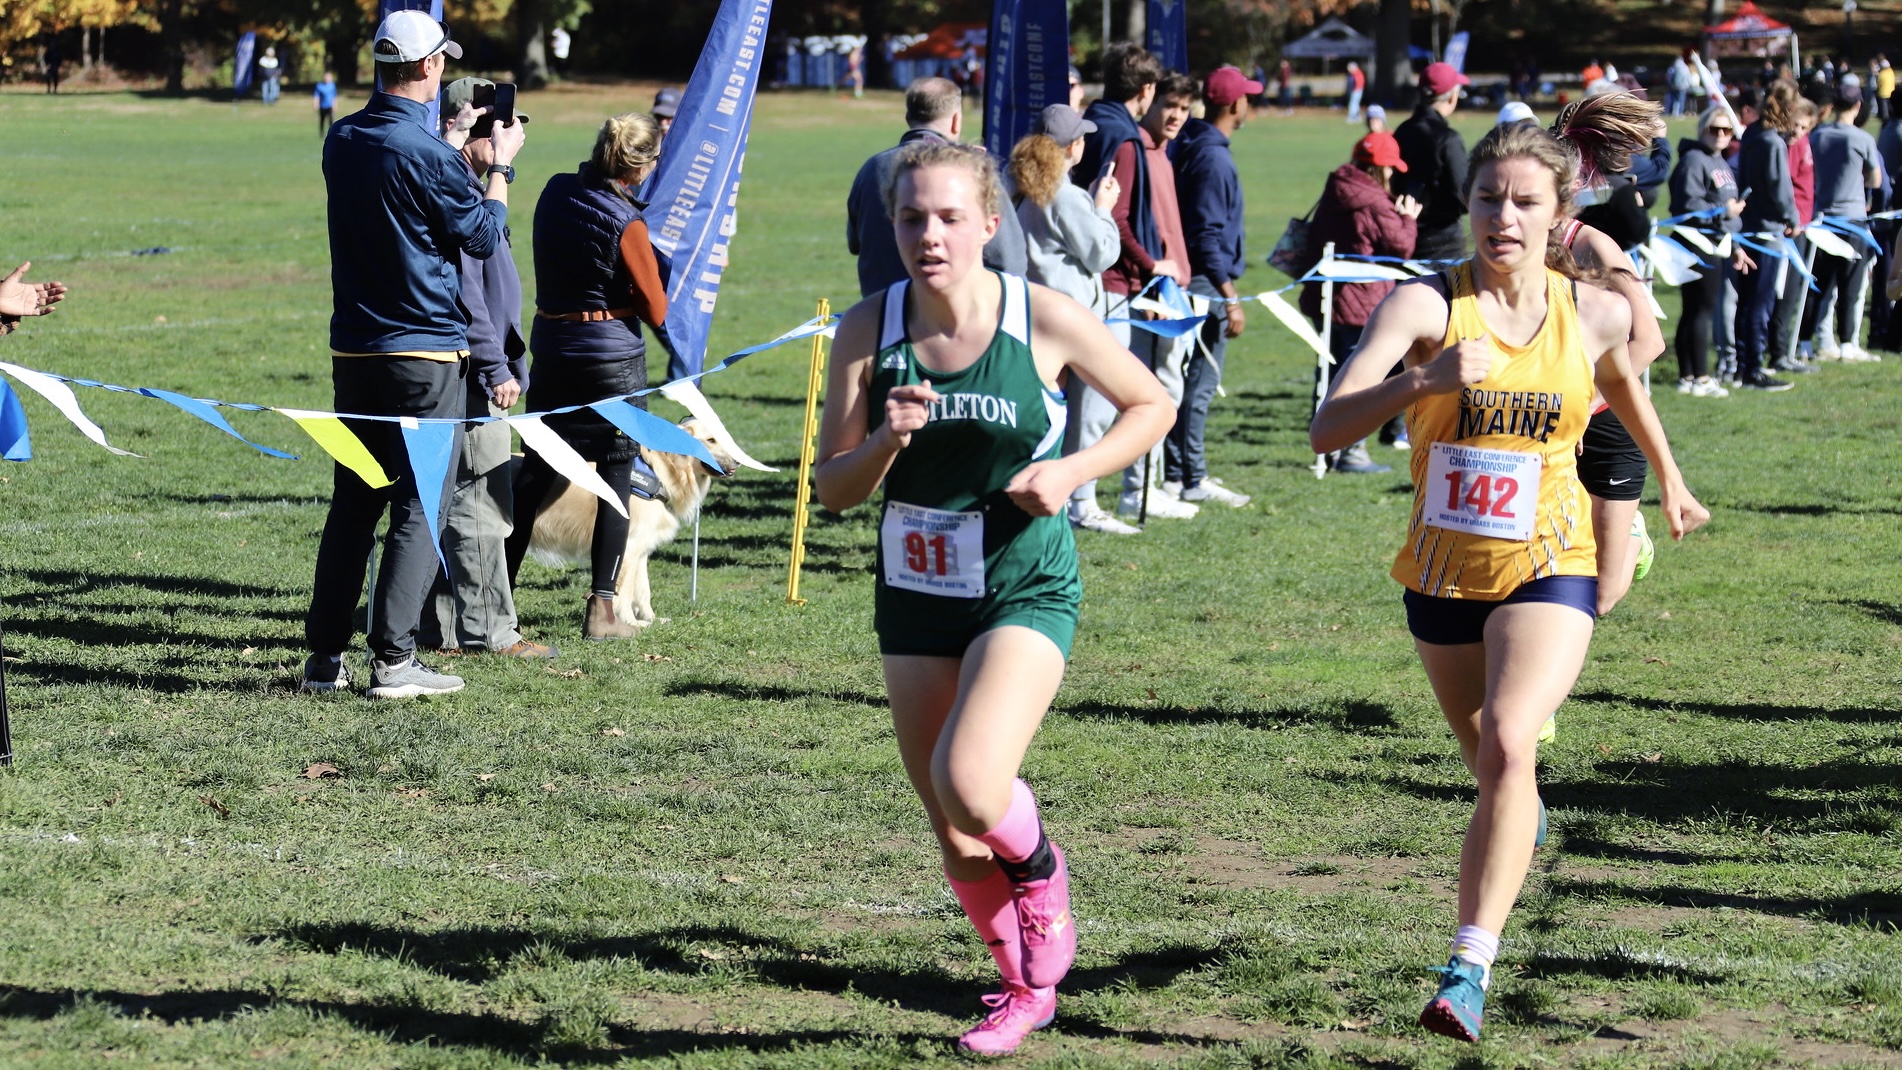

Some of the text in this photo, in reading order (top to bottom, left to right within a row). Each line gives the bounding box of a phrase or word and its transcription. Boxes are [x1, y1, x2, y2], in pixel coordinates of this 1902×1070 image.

[1460, 387, 1563, 411] SOUTHERN
[1455, 405, 1561, 444] MAINE
[1442, 446, 1526, 464] LITTLE EAST CONFERENCE
[1449, 456, 1517, 473] CHAMPIONSHIP
[1445, 470, 1519, 519] 142
[903, 515, 960, 531] CHAMPIONSHIP
[1439, 513, 1459, 523] HOSTED
[1492, 522, 1516, 531] BOSTON
[905, 532, 946, 576] 91
